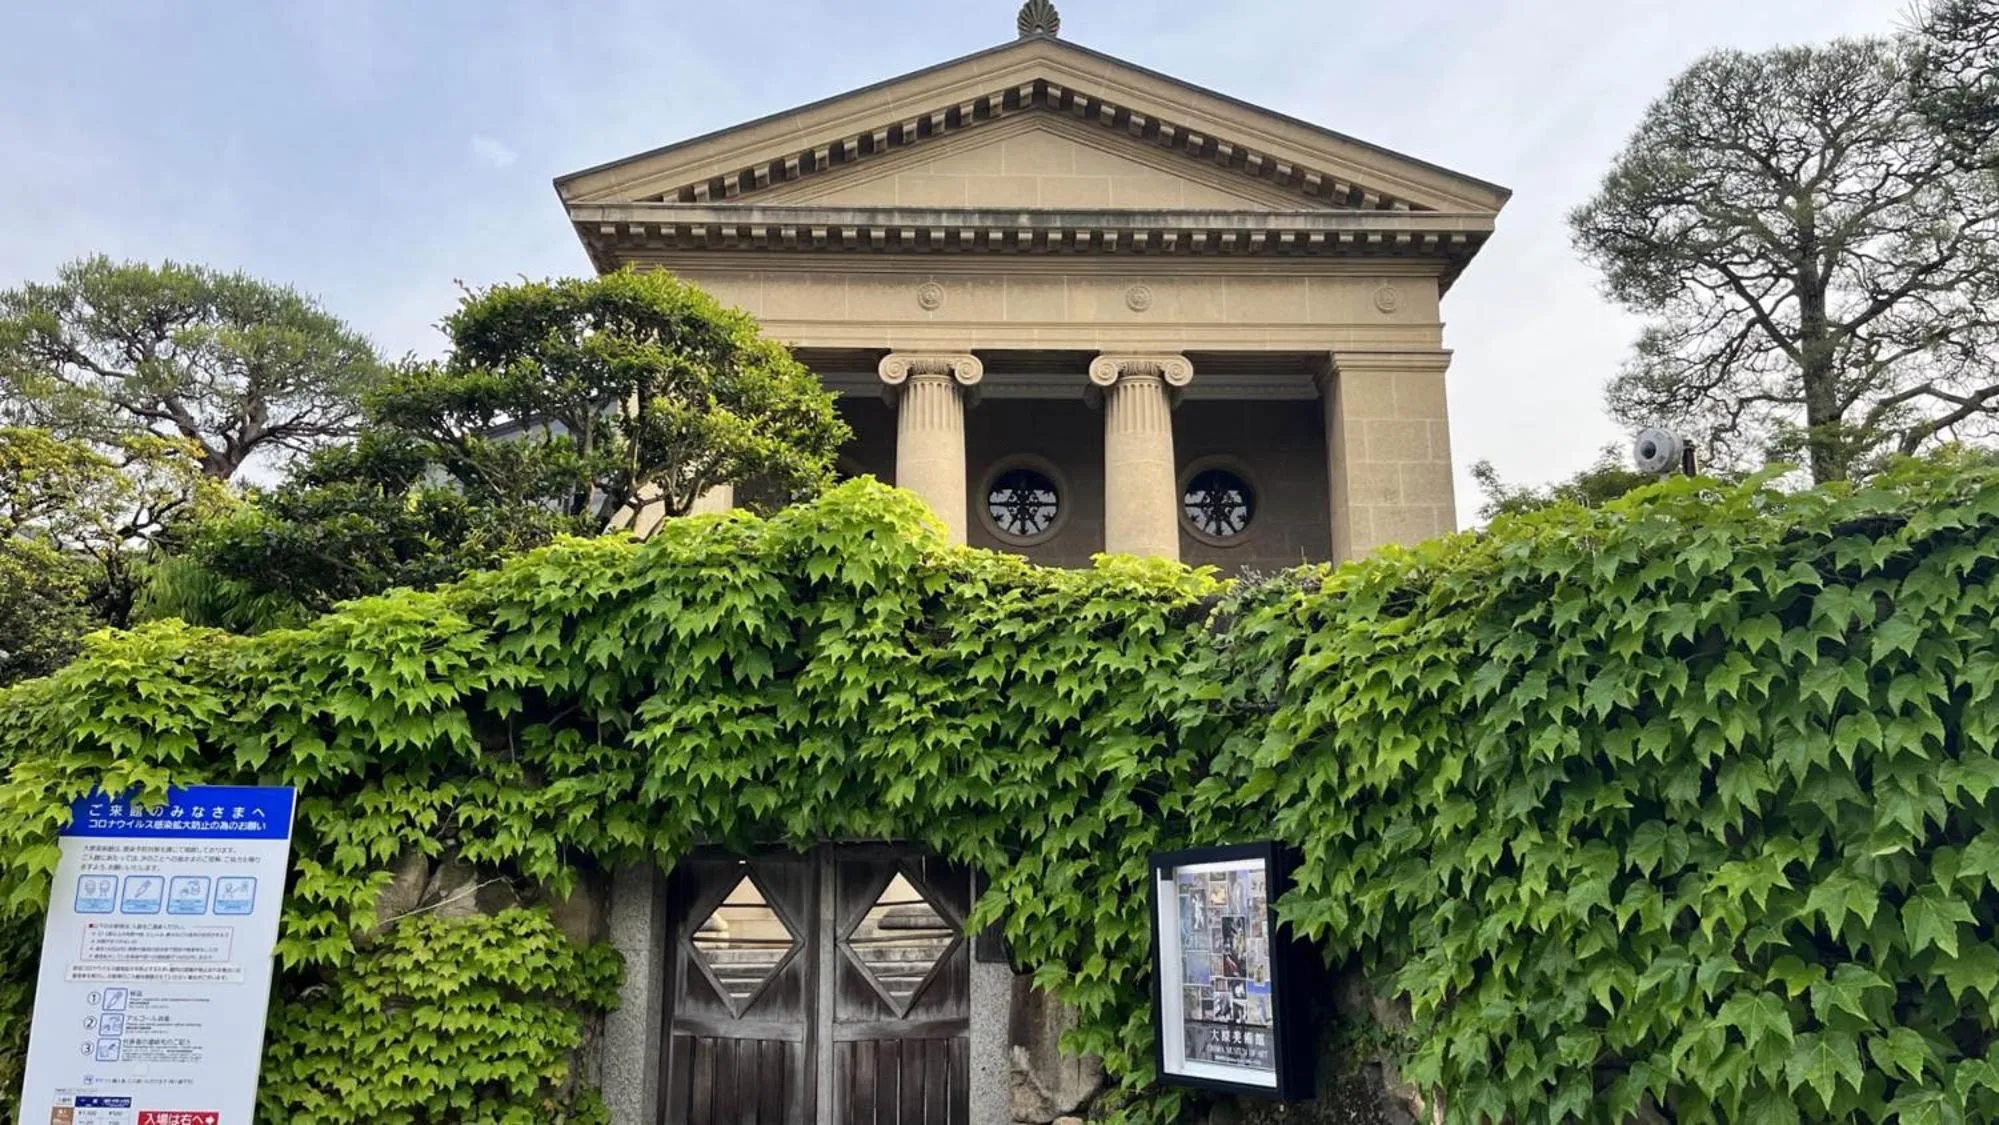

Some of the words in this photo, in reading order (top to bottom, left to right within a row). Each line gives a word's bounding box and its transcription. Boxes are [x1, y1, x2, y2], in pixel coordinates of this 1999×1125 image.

[88, 819, 266, 831] コロナウイルス感染拡大防止の為のお願い
